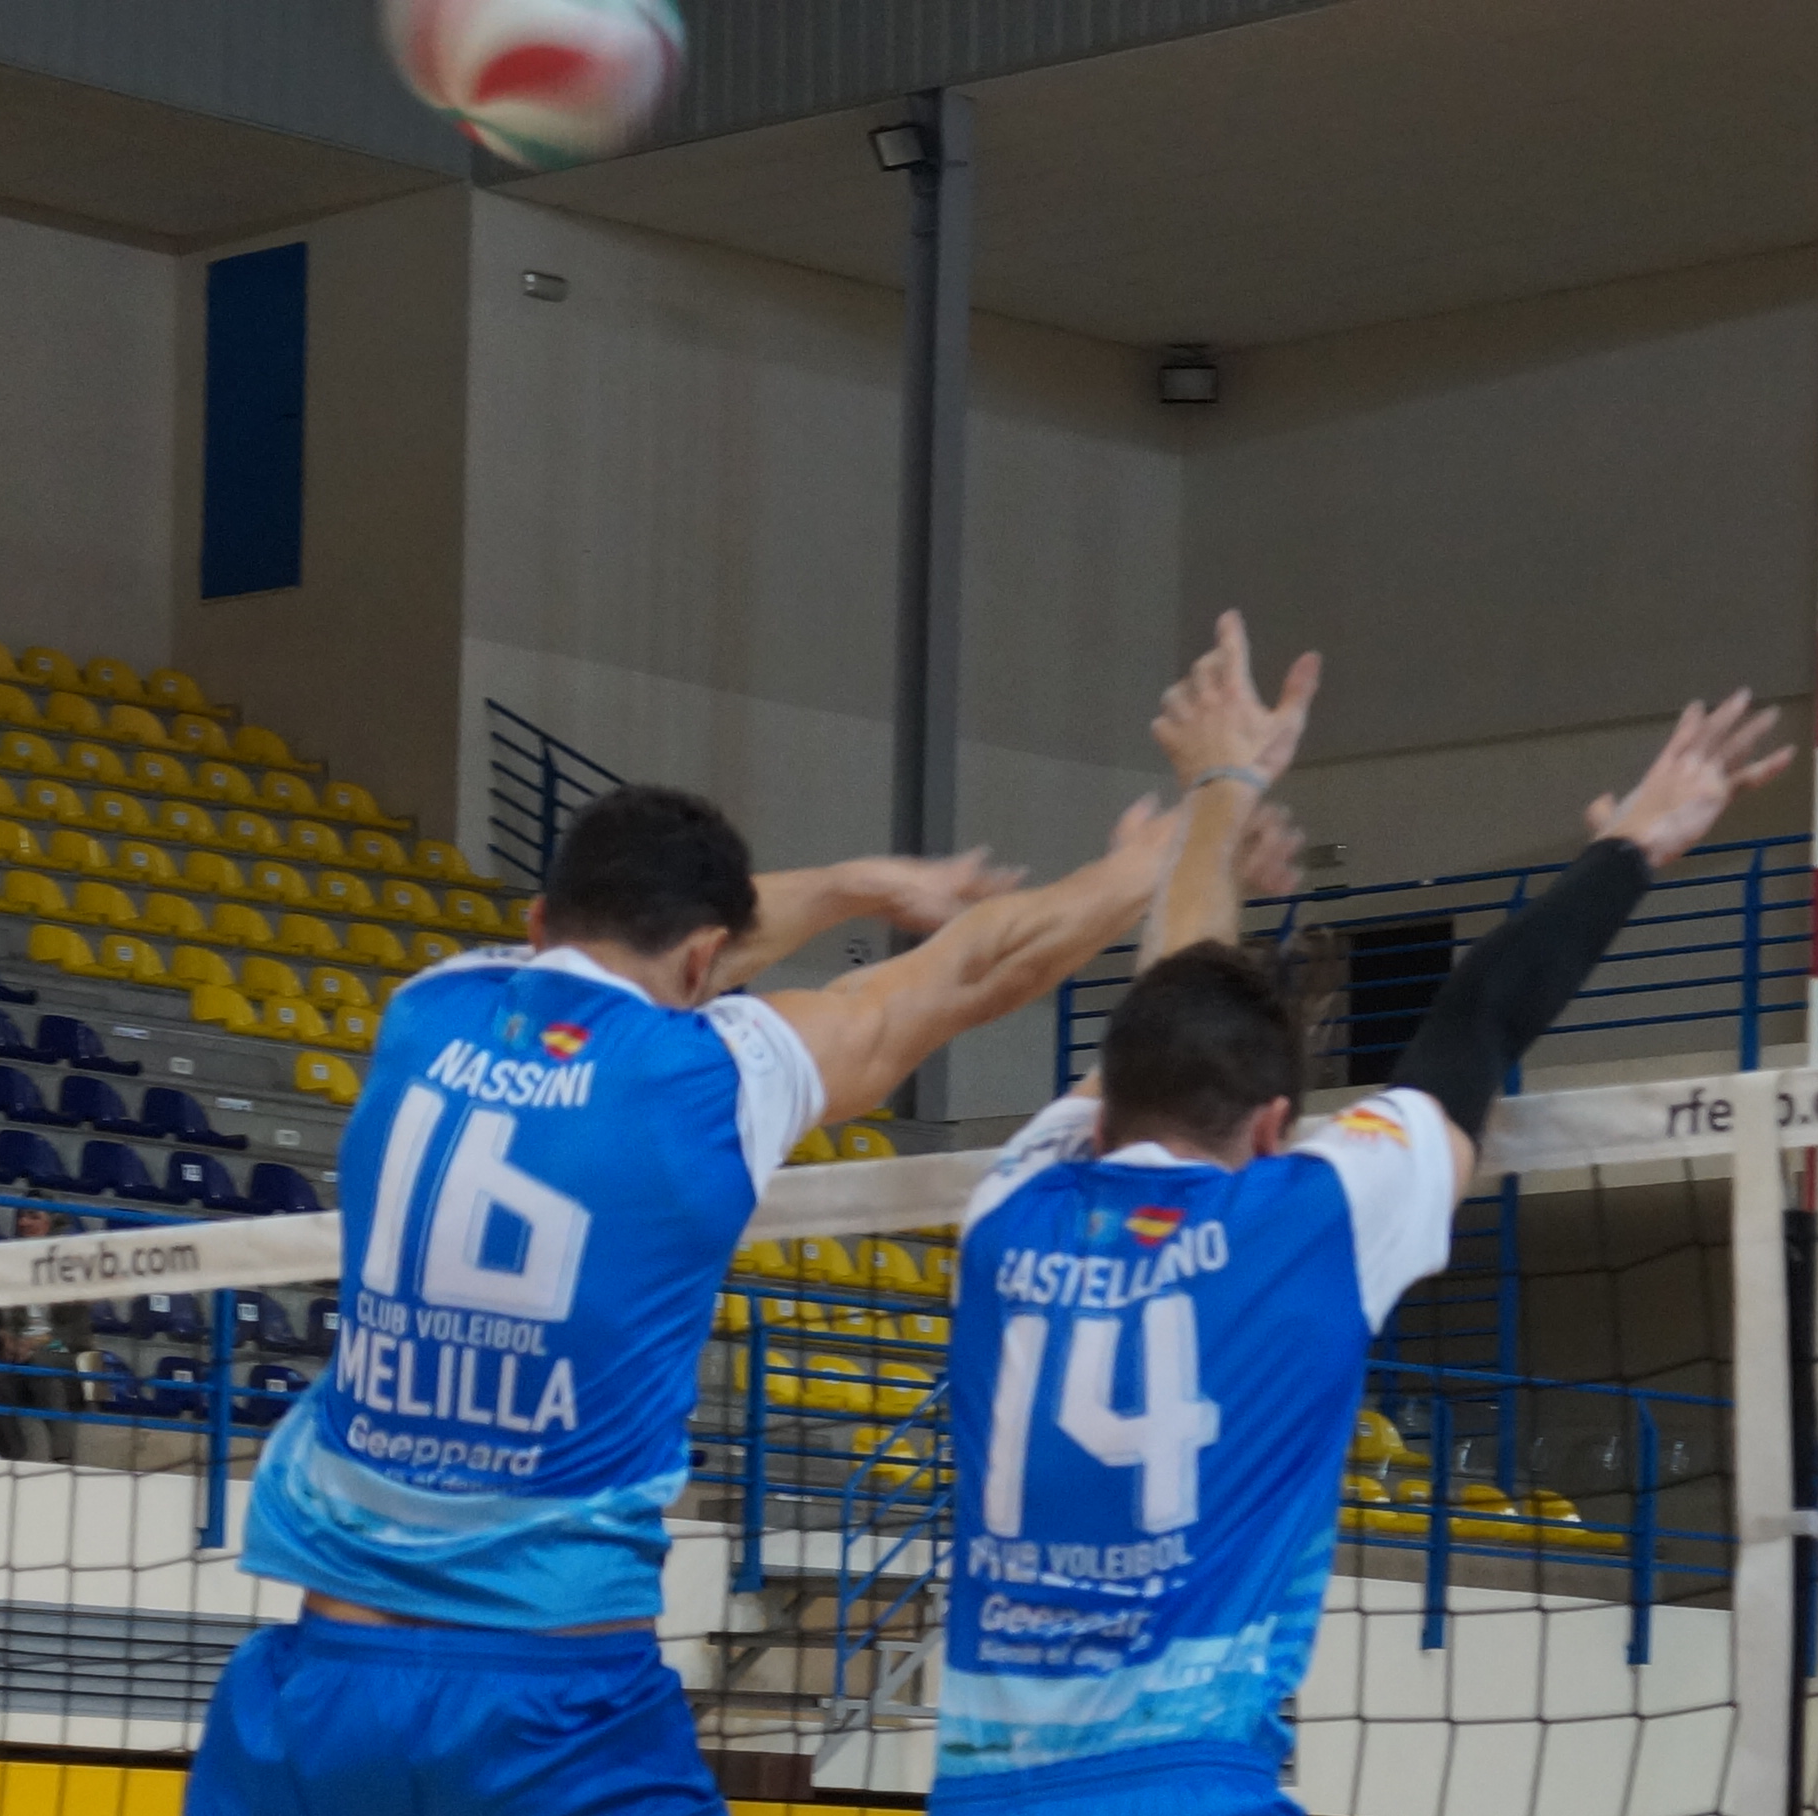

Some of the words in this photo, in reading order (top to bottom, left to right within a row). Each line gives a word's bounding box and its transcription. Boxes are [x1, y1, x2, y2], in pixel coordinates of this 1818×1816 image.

[426, 1038, 595, 1107] NASSINI
[361, 1081, 591, 1322] 16
[31, 1241, 199, 1287] rfevb.com
[356, 1290, 409, 1335] CLUB
[416, 1308, 548, 1356] VOLEIBOL
[337, 1316, 577, 1432] MELILLA
[347, 1413, 544, 1477] Geeppard
[984, 1294, 1221, 1538] 14
